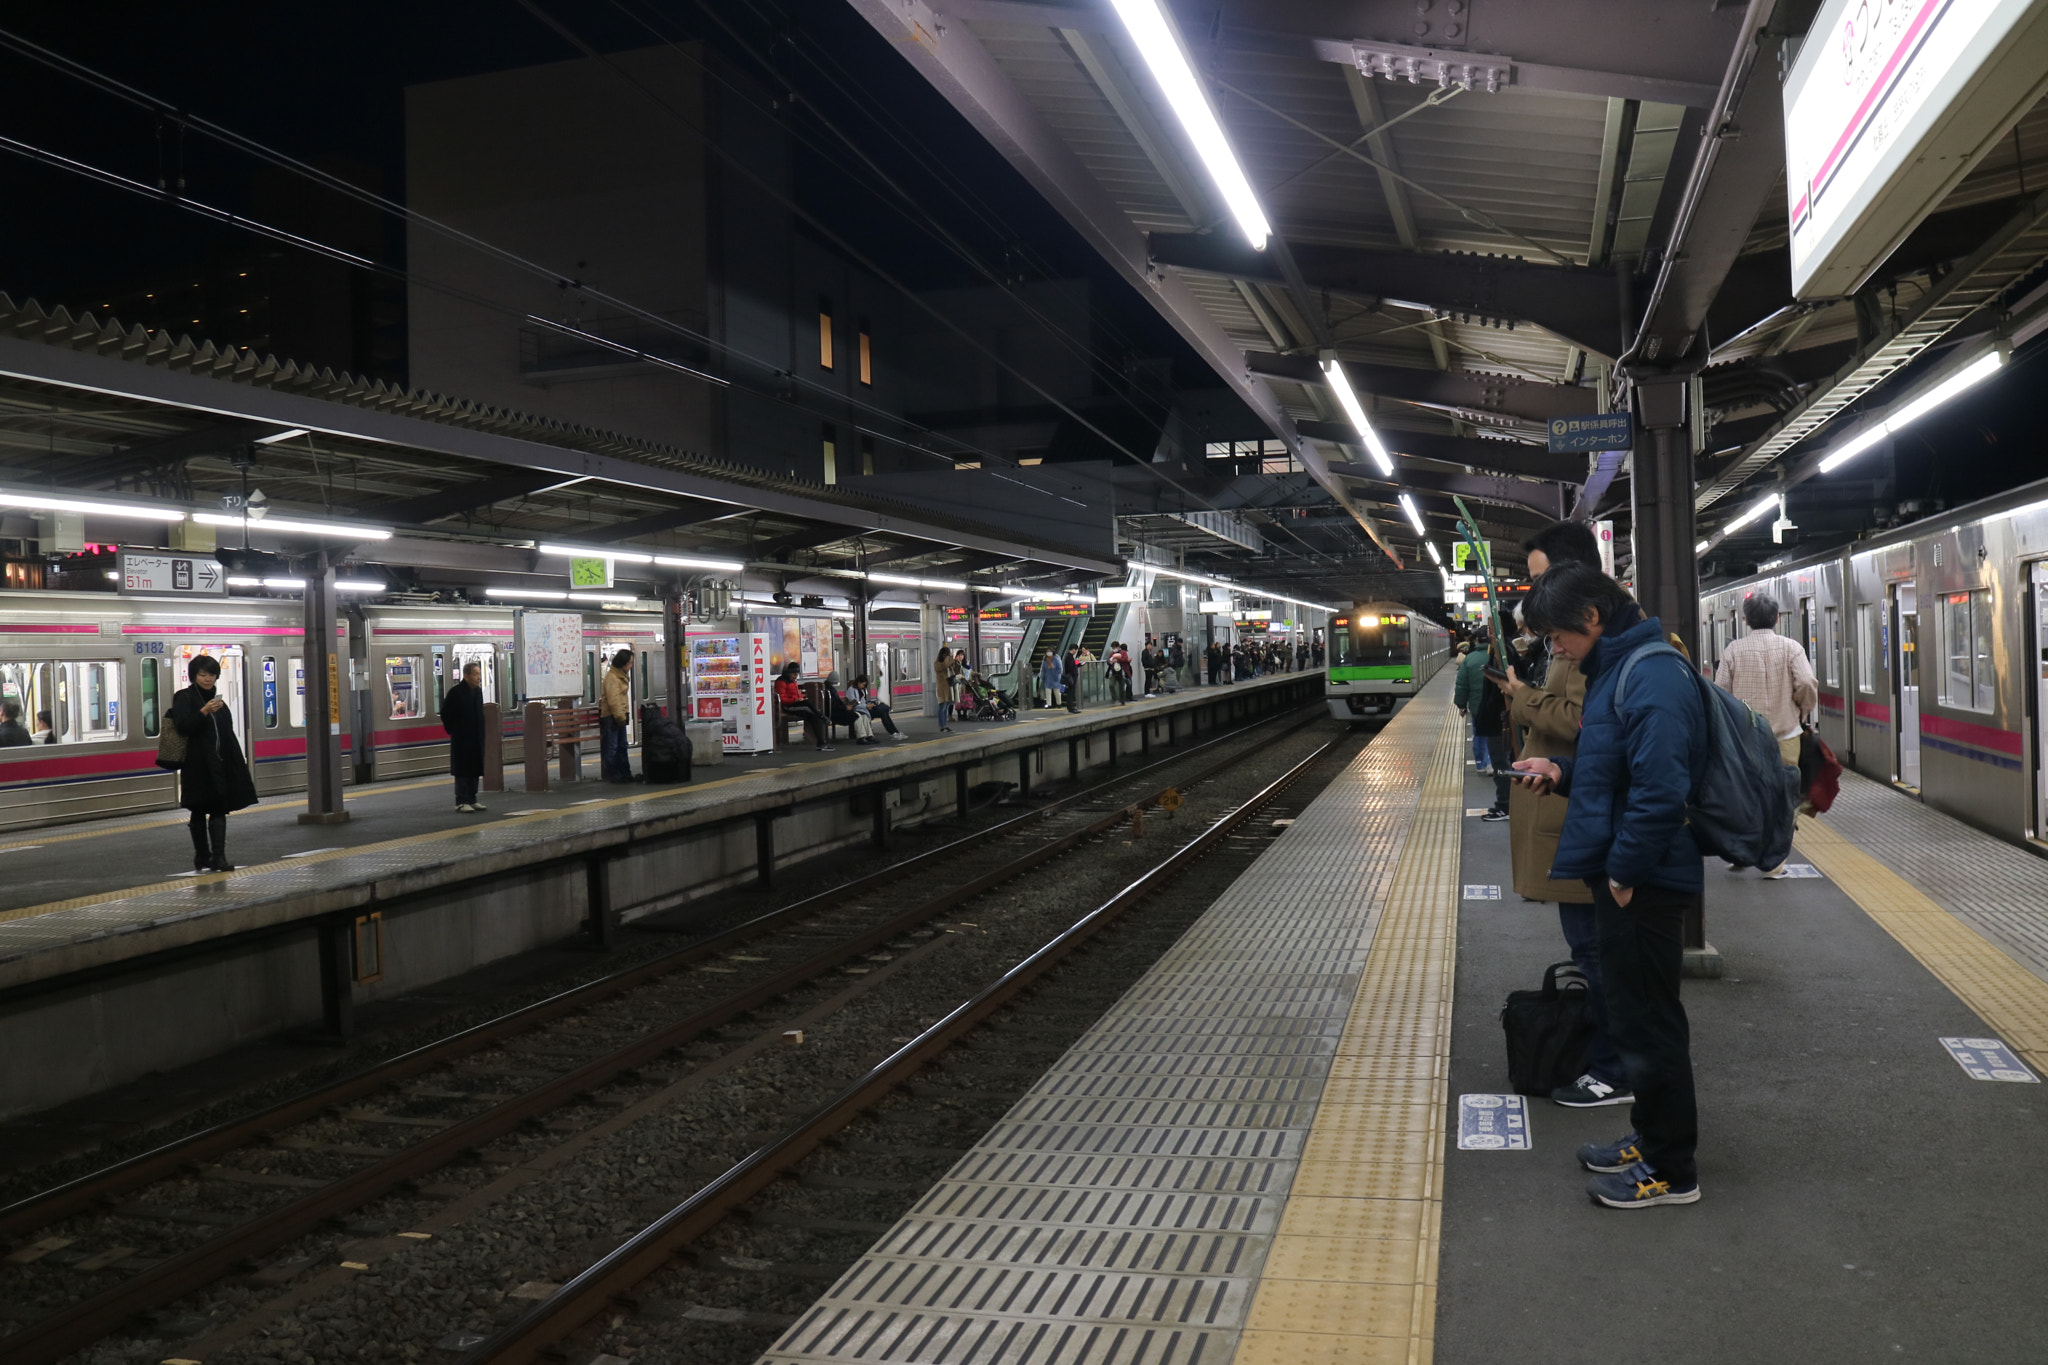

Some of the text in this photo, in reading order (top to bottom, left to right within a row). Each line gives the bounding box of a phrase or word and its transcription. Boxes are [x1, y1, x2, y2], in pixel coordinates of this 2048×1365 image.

[1581, 418, 1626, 430] 駅係員呼出
[1570, 434, 1627, 446] インターホン
[222, 496, 241, 508] 下り
[126, 557, 169, 567] エレベーター
[126, 576, 152, 588] 51m
[136, 642, 164, 654] 8182
[754, 638, 765, 715] KIRIN
